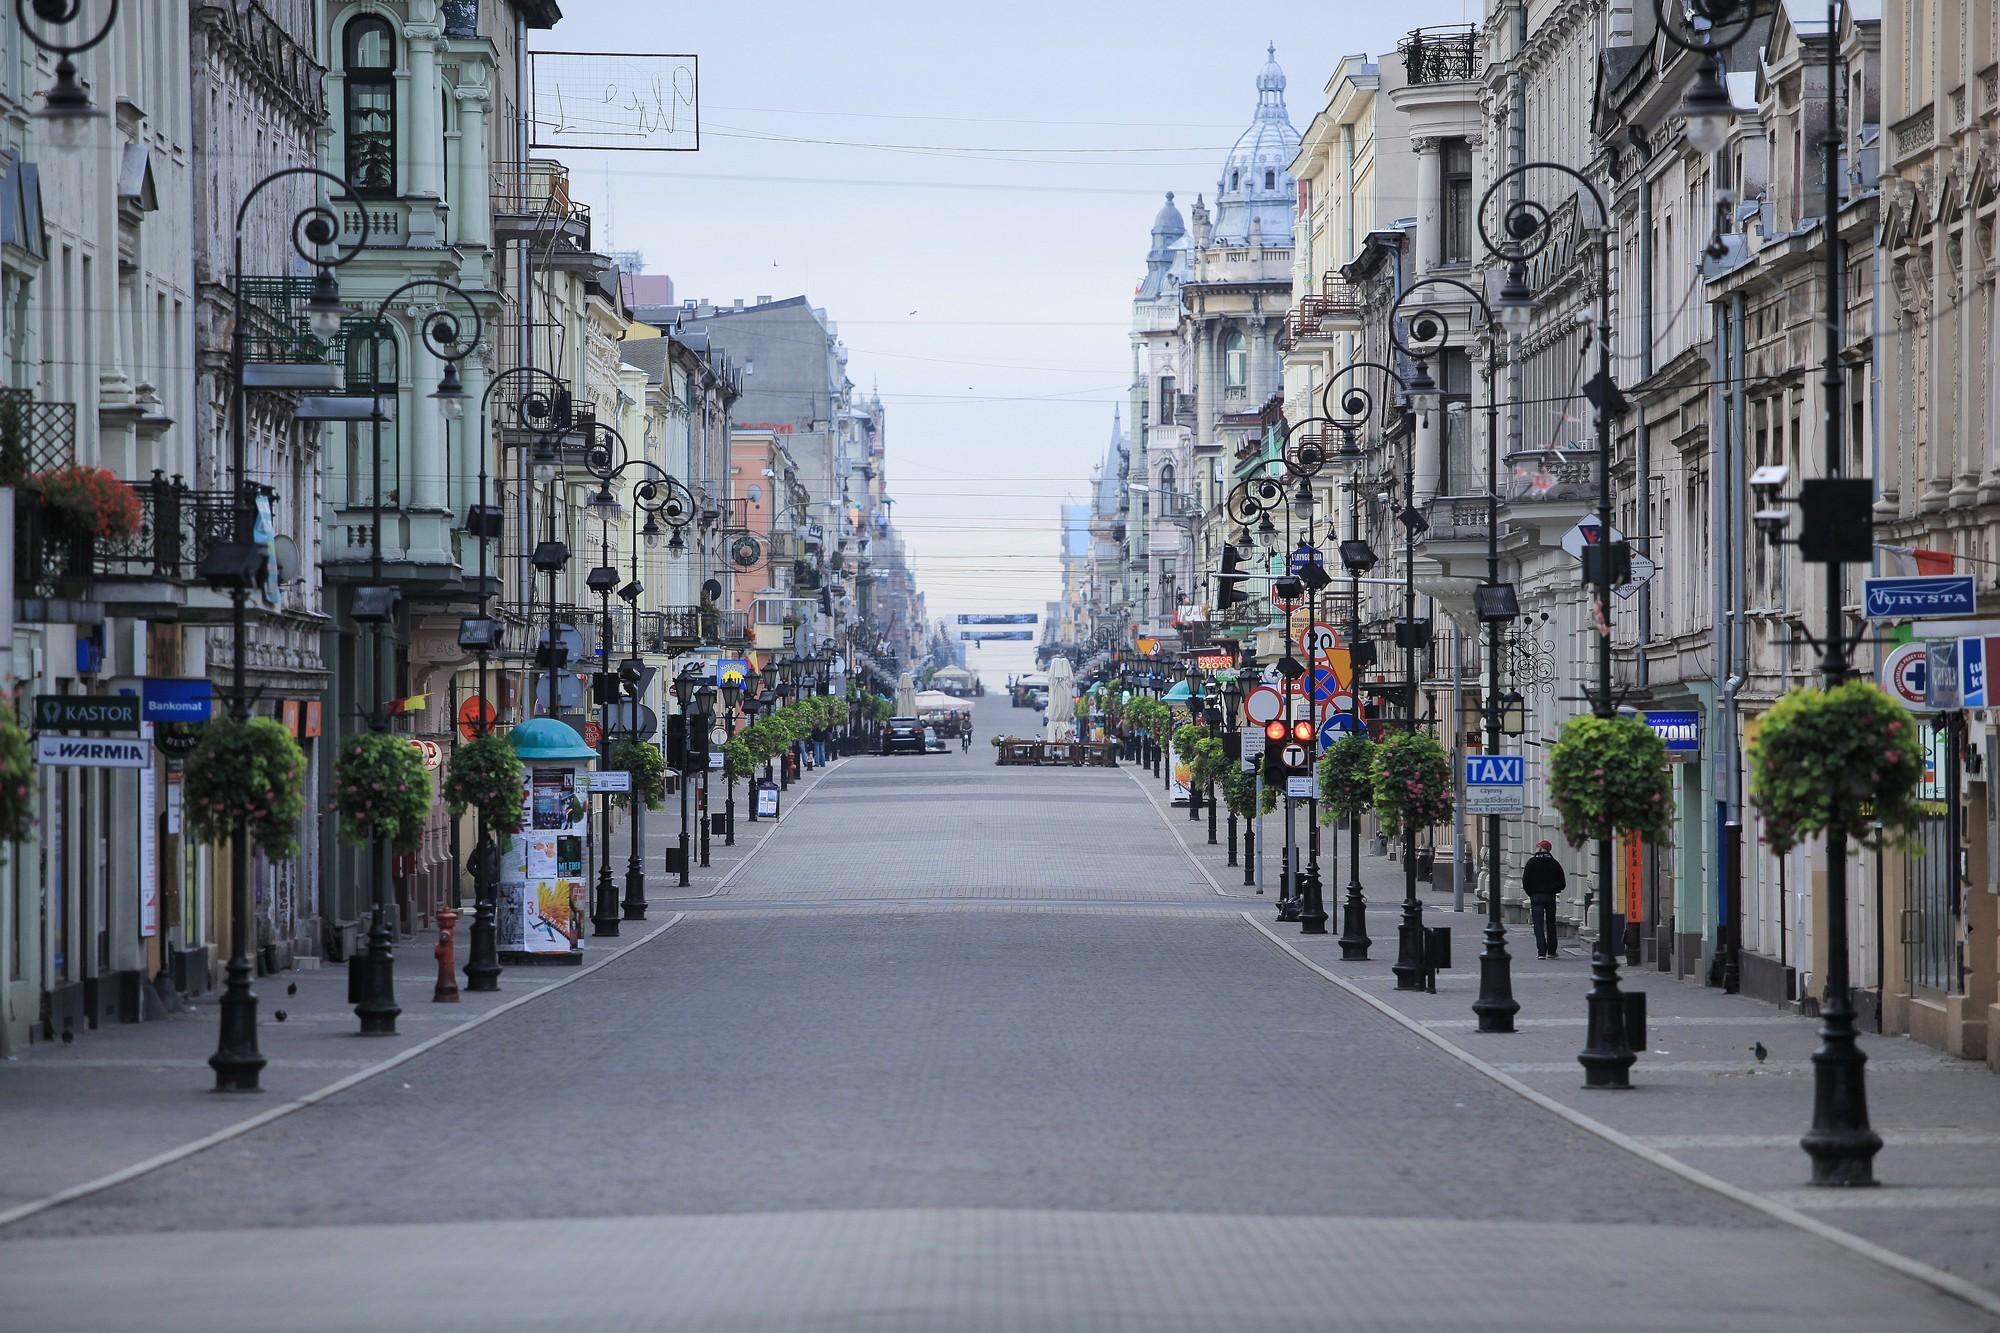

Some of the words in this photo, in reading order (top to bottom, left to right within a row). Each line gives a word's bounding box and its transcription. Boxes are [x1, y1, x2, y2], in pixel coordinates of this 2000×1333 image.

[66, 706, 133, 721] KASTOR
[149, 701, 203, 711] Bankomat
[59, 743, 144, 760] WARMIA
[1467, 759, 1520, 782] TAXI
